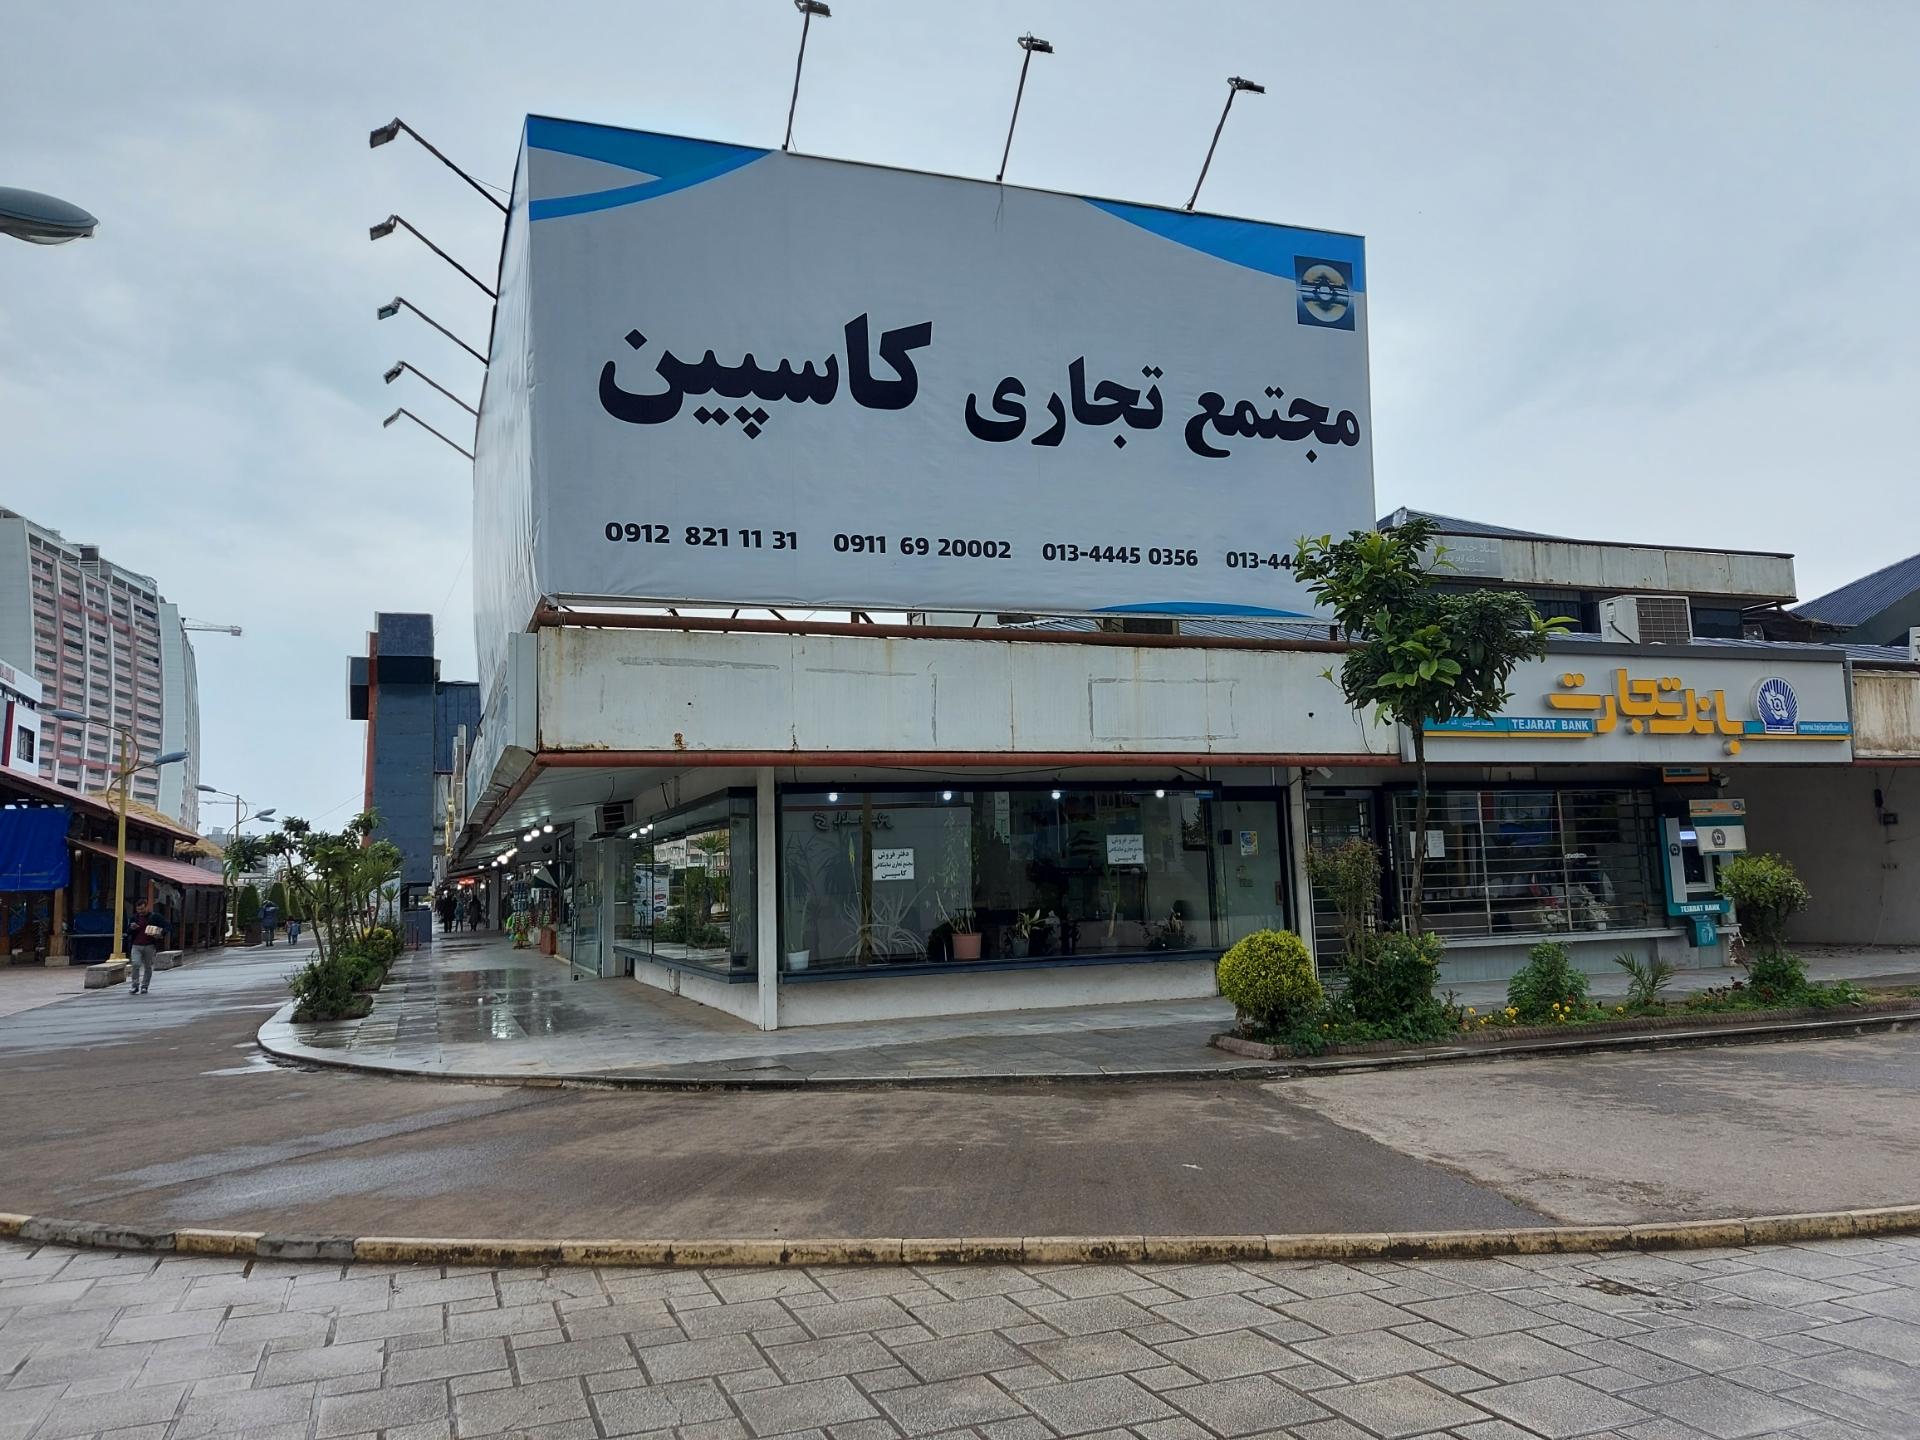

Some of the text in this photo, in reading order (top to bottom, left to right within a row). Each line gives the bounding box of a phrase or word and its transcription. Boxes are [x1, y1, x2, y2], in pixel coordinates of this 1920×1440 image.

[598, 312, 1361, 464] مجتمع تجاری کاسپین
[605, 522, 670, 544] 0912
[684, 526, 729, 547] 821
[738, 529, 762, 549] 11
[772, 530, 797, 550] 31
[833, 533, 886, 554] 0911
[900, 536, 930, 556] 69
[937, 538, 1012, 559] 20002
[1042, 542, 1141, 565] 013-4445
[1148, 547, 1199, 567] 0356
[1548, 668, 1684, 734] تجارت
[1511, 719, 1589, 731] TEJARAT BANK
[1704, 903, 1721, 911] BANK
